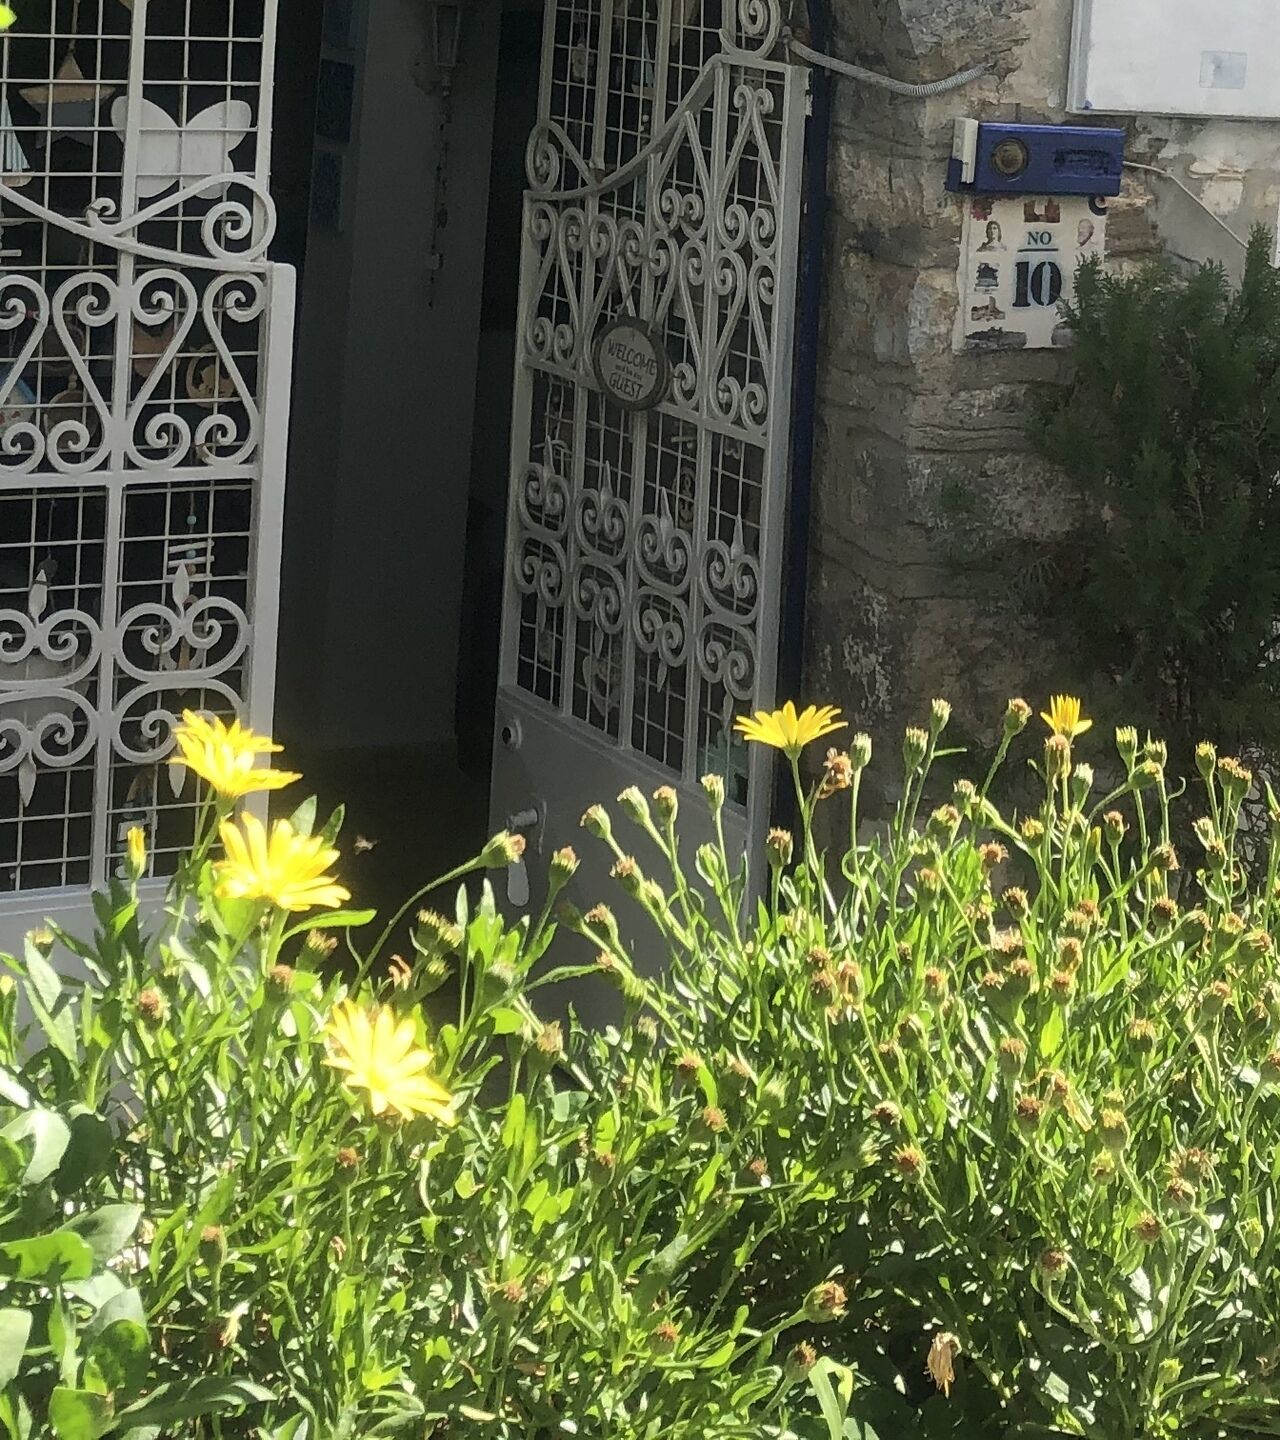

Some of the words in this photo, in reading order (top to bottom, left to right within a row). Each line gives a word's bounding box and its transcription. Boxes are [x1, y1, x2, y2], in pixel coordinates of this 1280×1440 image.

[1027, 231, 1052, 246] NO
[1012, 261, 1062, 307] 10
[608, 339, 658, 375] WELCOME
[609, 372, 643, 398] GUEST
